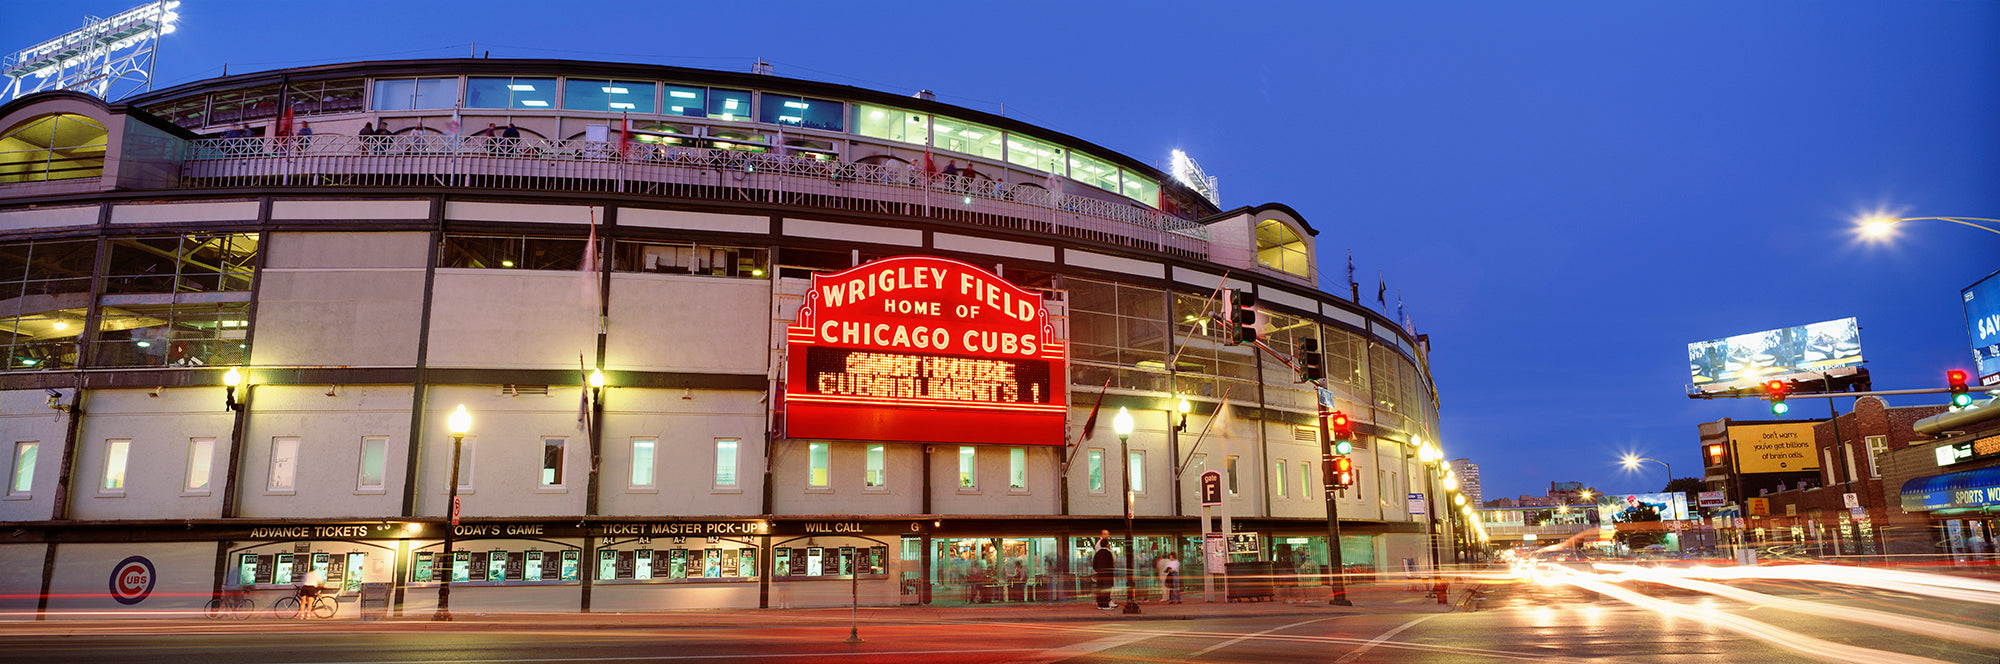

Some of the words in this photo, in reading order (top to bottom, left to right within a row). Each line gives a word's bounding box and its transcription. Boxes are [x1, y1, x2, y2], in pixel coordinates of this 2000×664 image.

[822, 266, 947, 308] WRIGLEY
[960, 272, 1035, 322] FIELD
[884, 299, 941, 316] HOME
[956, 304, 980, 319] OF
[821, 320, 950, 350] CHICAGO
[963, 330, 1037, 355] CUBS
[1753, 441, 1773, 451] you've
[1204, 474, 1217, 483] gate
[1206, 484, 1215, 501] F
[1955, 489, 1984, 505] SPORTS
[250, 527, 309, 538] ADVANCE
[314, 526, 368, 537] TICKETS
[453, 524, 501, 536] ODAY'S
[506, 524, 544, 535] GAME
[601, 524, 647, 534] TICKET
[651, 523, 702, 534] MASTER
[706, 523, 758, 533] PICK-UP
[805, 522, 833, 533] WILL
[835, 522, 863, 533] CALL
[910, 522, 919, 532] G
[638, 536, 651, 544] A-L
[673, 536, 686, 544] A-Z
[708, 535, 720, 543] M-Z
[742, 535, 754, 543] M-Z
[119, 565, 148, 595] CUBS
